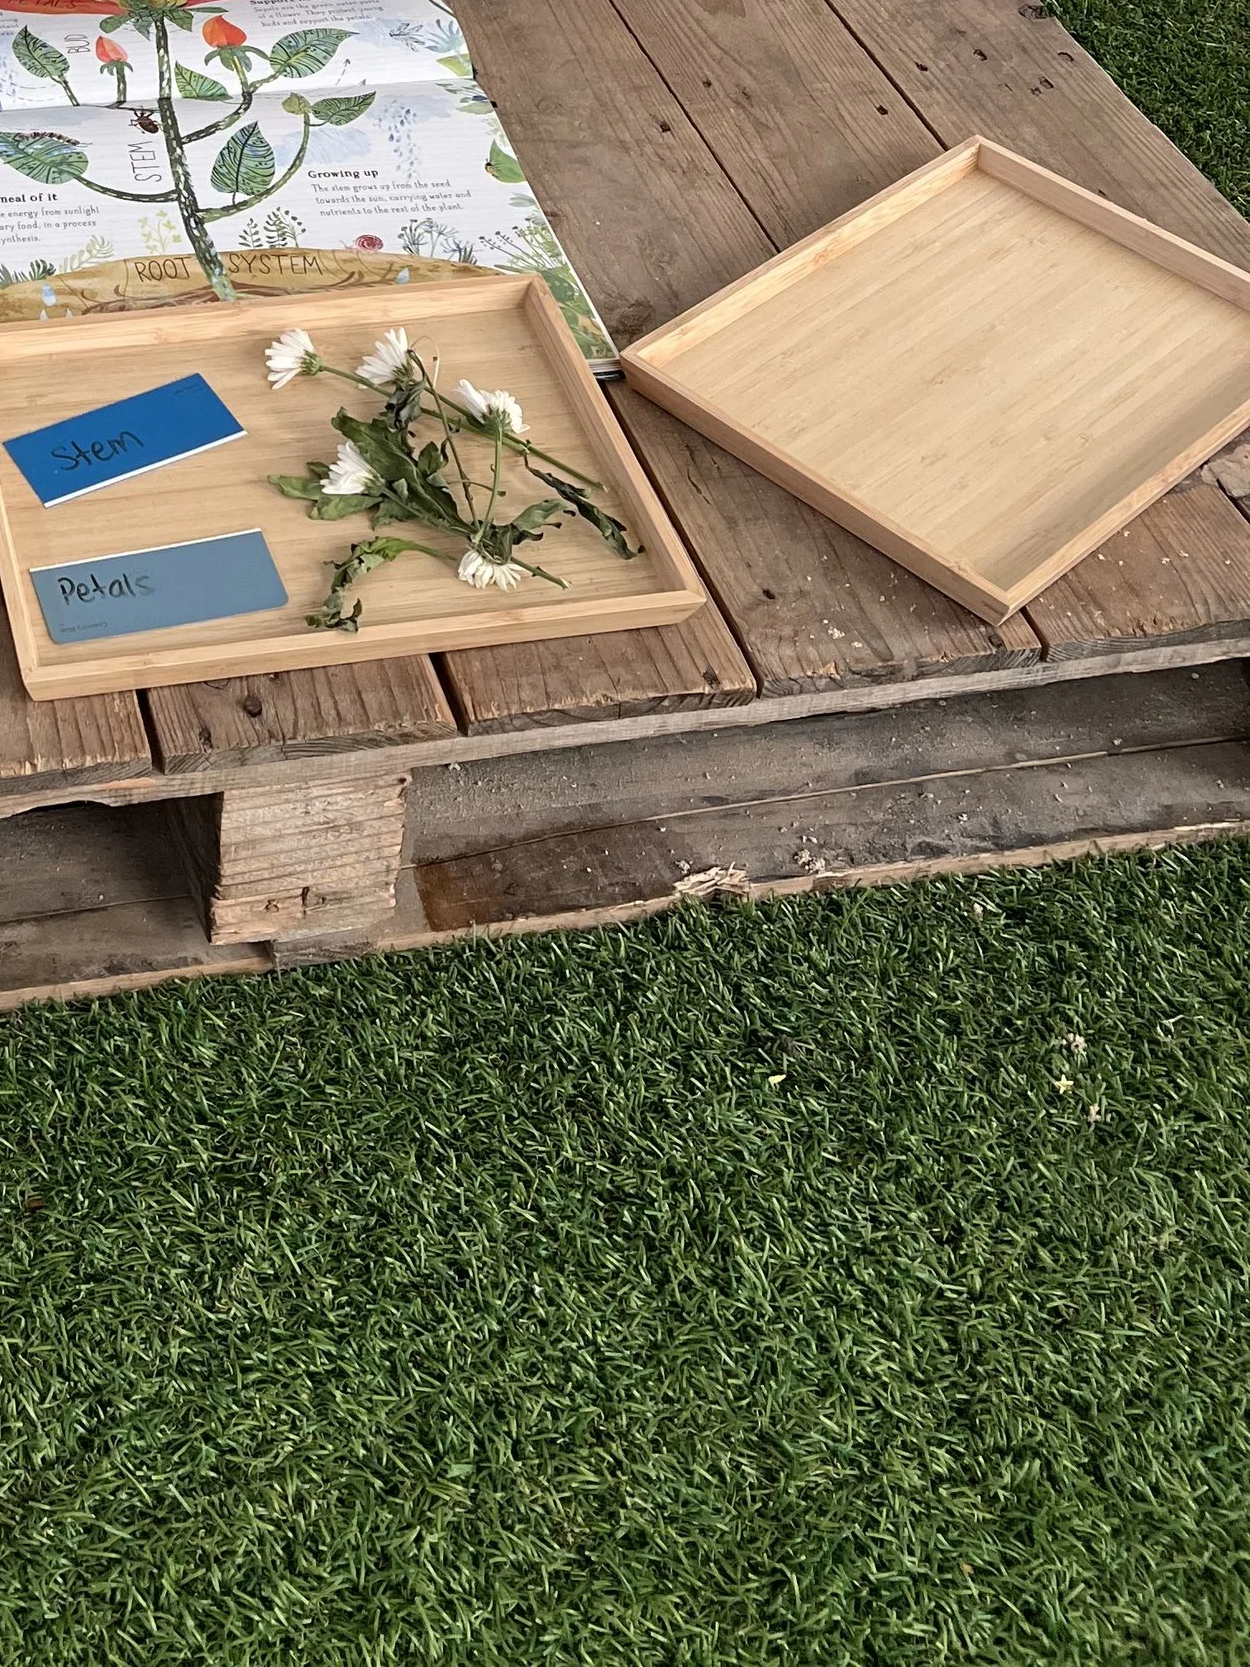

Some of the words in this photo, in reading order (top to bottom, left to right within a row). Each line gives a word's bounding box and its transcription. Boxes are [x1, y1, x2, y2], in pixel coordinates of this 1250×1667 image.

[64, 34, 90, 54] BUD
[127, 140, 162, 182] STEM
[308, 170, 360, 180] Growing
[364, 170, 379, 179] up
[312, 184, 328, 192] The
[332, 184, 350, 192] stem
[353, 184, 378, 193] grows
[392, 181, 412, 190] from
[414, 180, 428, 189] the
[432, 179, 451, 188] seed
[30, 193, 44, 202] of
[48, 193, 58, 202] it
[316, 196, 350, 204] towards
[352, 194, 366, 203] the
[390, 194, 428, 203] carrying
[429, 192, 452, 200] water
[456, 190, 471, 198] and
[8, 210, 38, 220] energy
[42, 206, 62, 216] from
[64, 206, 100, 216] sunlight
[320, 208, 362, 217] nutrients
[363, 207, 372, 215] to
[374, 206, 389, 214] the
[391, 205, 408, 214] rest
[411, 204, 420, 212] of
[422, 203, 436, 212] the
[63, 220, 97, 230] process
[134, 256, 191, 282] ROOT
[228, 253, 324, 276] SYSTEM
[52, 430, 144, 473] Stem
[58, 572, 155, 606] Petals
